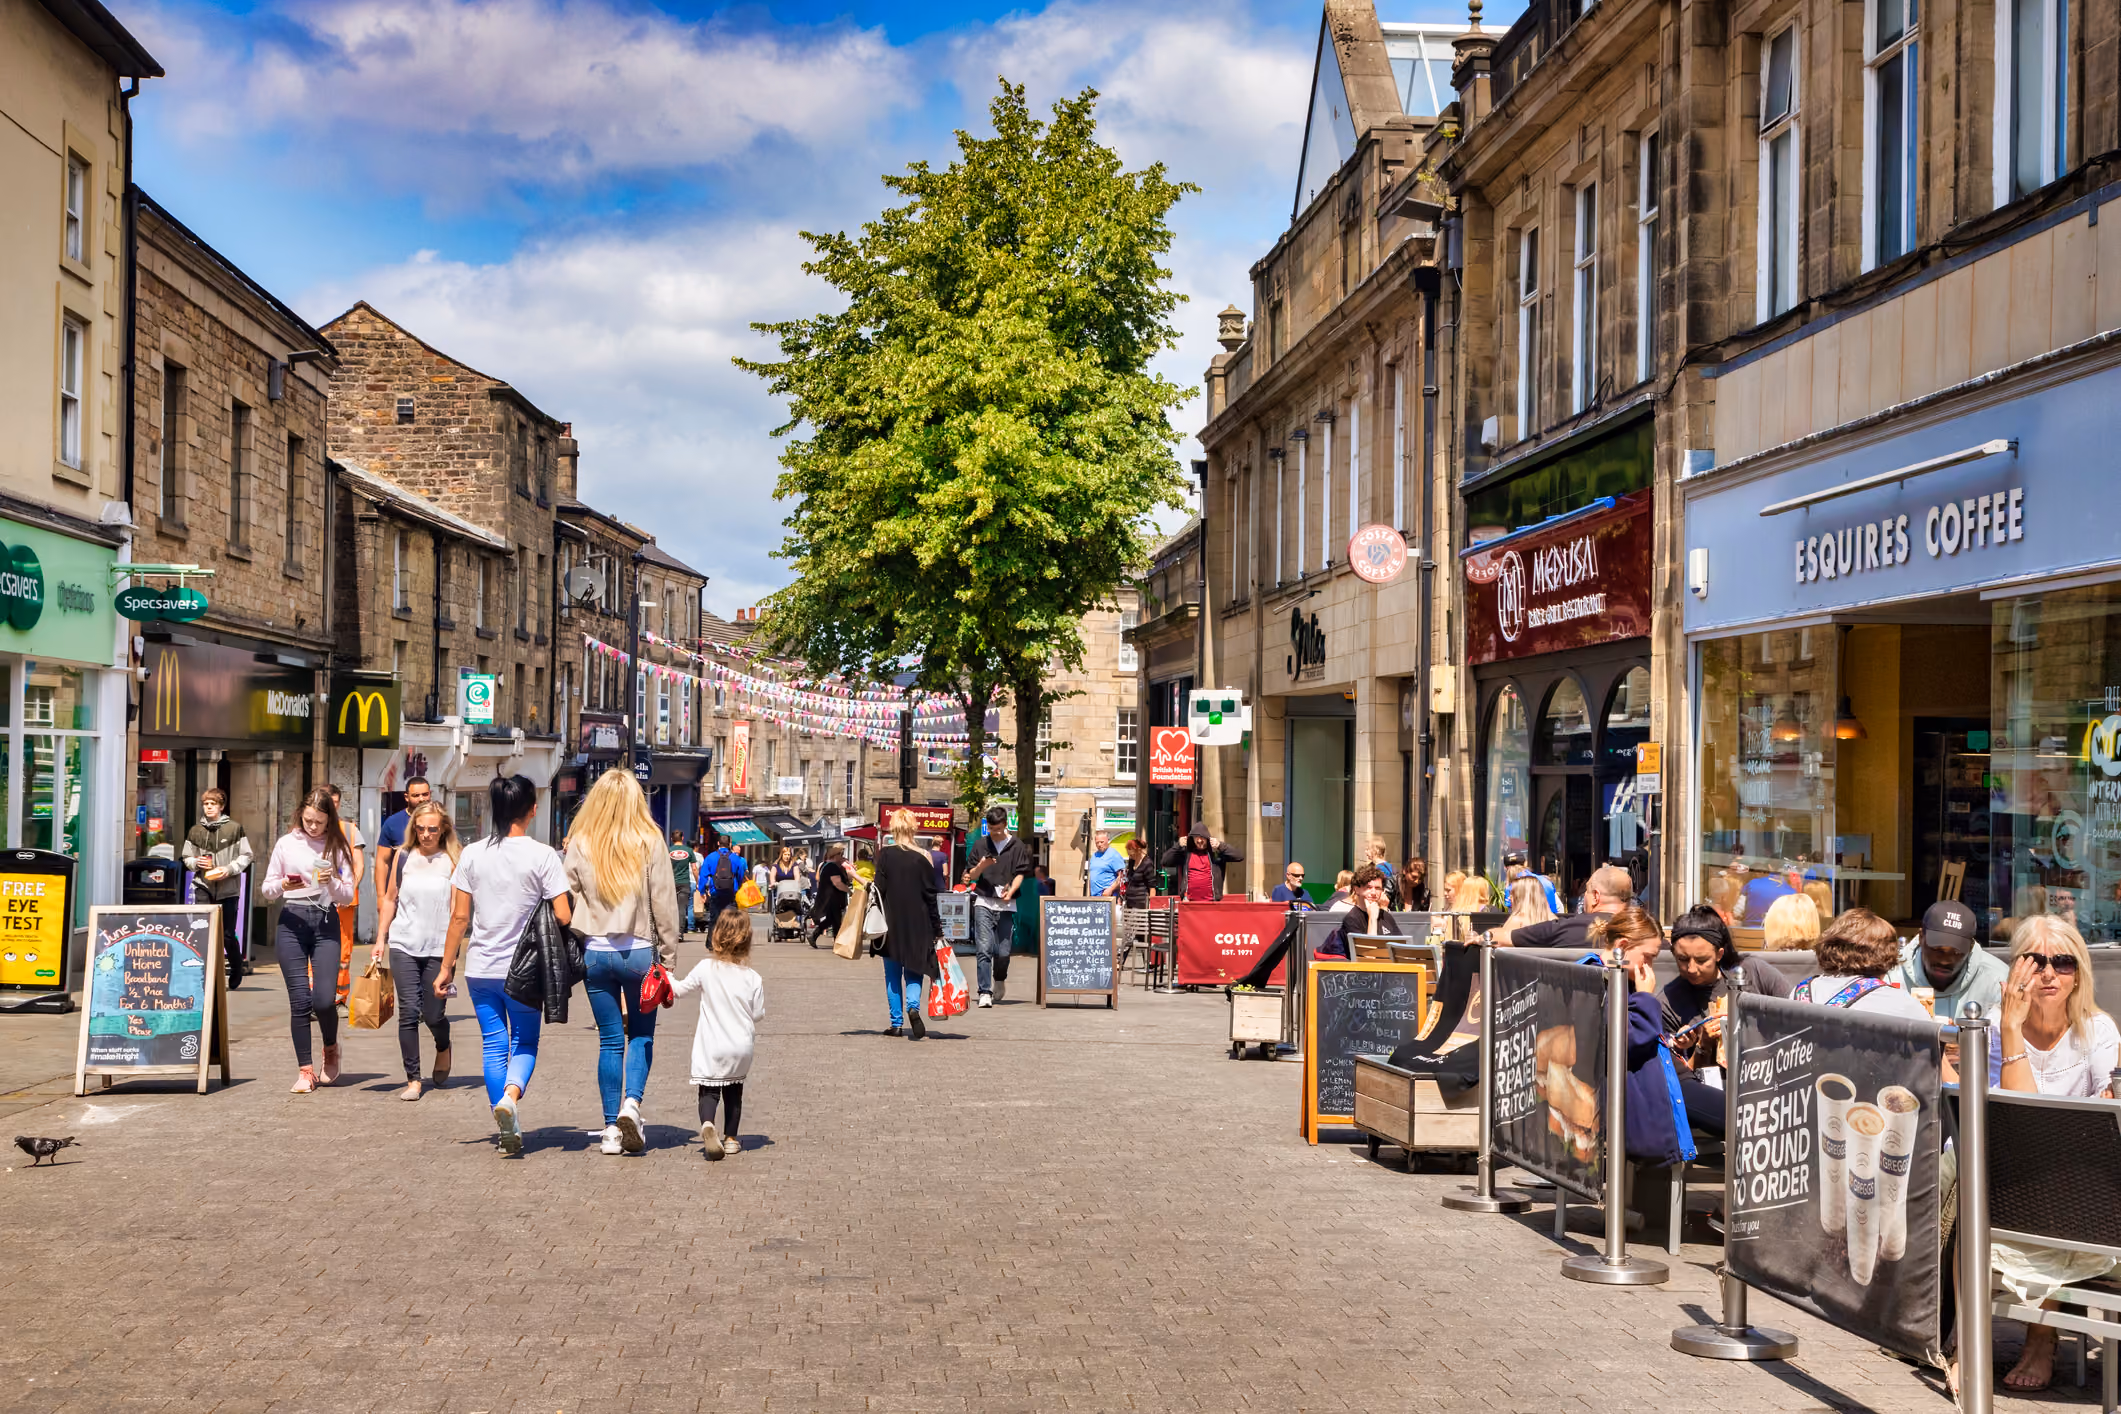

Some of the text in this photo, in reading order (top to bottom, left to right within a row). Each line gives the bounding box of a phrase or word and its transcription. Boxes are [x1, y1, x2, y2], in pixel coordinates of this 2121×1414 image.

[1359, 530, 1395, 546] COSTA
[1796, 487, 2023, 583] ESQUIRES COFFEE
[1358, 558, 1401, 577] COFFEE
[1532, 535, 1599, 596] MEDUSA
[0, 571, 39, 601] csavers
[124, 596, 199, 612] Specsavers
[267, 689, 310, 718] McDonald's
[1152, 766, 1173, 774] British
[1152, 773, 1192, 781] Foundation
[930, 811, 950, 819] Burger
[923, 820, 949, 828] £4.00
[2, 880, 46, 897] FREE
[8, 899, 39, 913] EYE
[2, 915, 43, 931] TEST
[1947, 911, 1961, 921] THE
[1943, 919, 1963, 930] CLUB
[99, 924, 131, 946] June
[1214, 933, 1260, 946] COSTA
[124, 942, 170, 958] Unlimited
[132, 958, 162, 969] Home
[1086, 956, 1105, 964] RICE
[124, 971, 169, 985] Broadband
[143, 987, 164, 996] Price
[119, 998, 135, 1009] For
[140, 999, 149, 1009] 6
[1348, 999, 1381, 1010] JACKET
[1511, 988, 1537, 1017] Sandwic
[127, 1014, 143, 1025] Yes
[1366, 1009, 1416, 1020] POTATOES
[128, 1026, 153, 1036] Please
[1376, 1029, 1401, 1040] DELI
[1495, 1021, 1537, 1070] FRSHLY
[1740, 1038, 1814, 1086] Every Coffee
[1773, 1081, 1779, 1092] is
[1736, 1084, 1813, 1139] FRESHLY
[1733, 1164, 1809, 1206] TO ORDER
